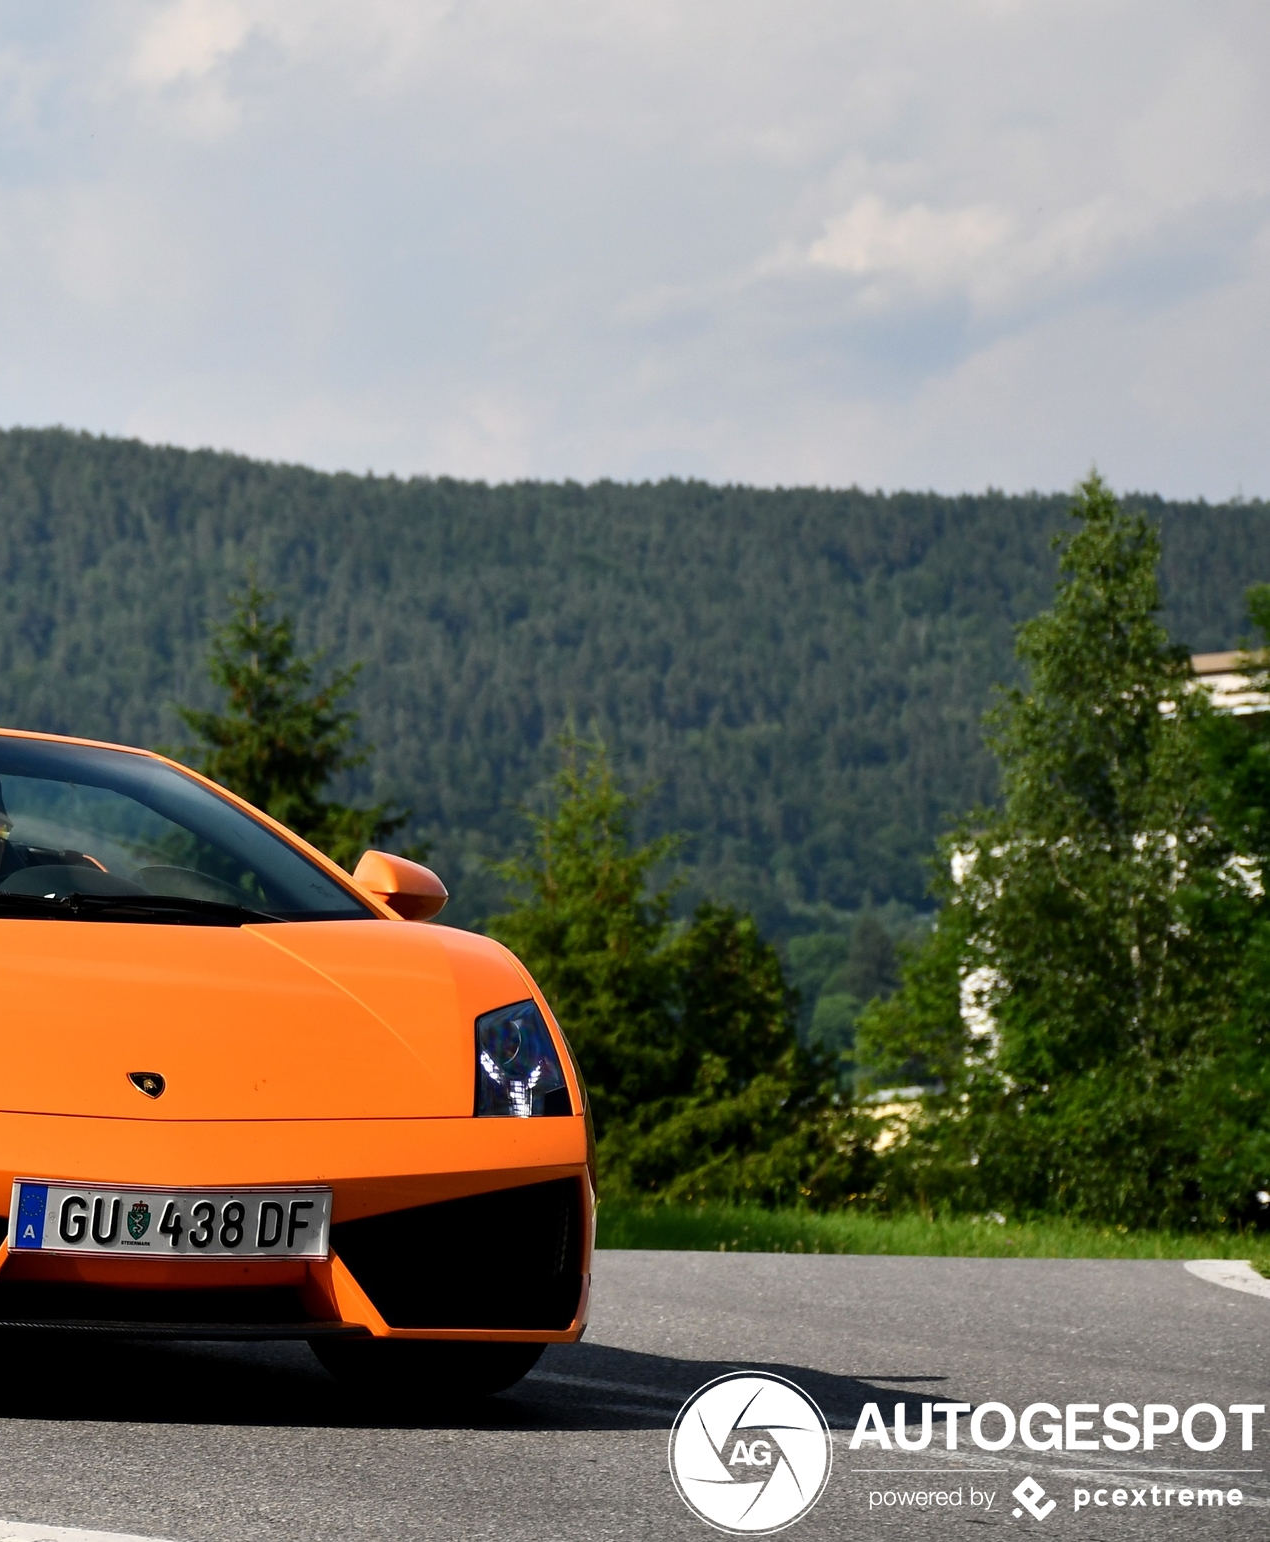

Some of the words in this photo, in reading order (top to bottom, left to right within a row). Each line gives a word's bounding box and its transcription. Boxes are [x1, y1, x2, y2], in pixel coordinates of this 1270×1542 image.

[22, 1224, 36, 1239] A
[58, 1195, 122, 1247] GU
[158, 1200, 247, 1250] 438
[256, 1200, 315, 1249] DF
